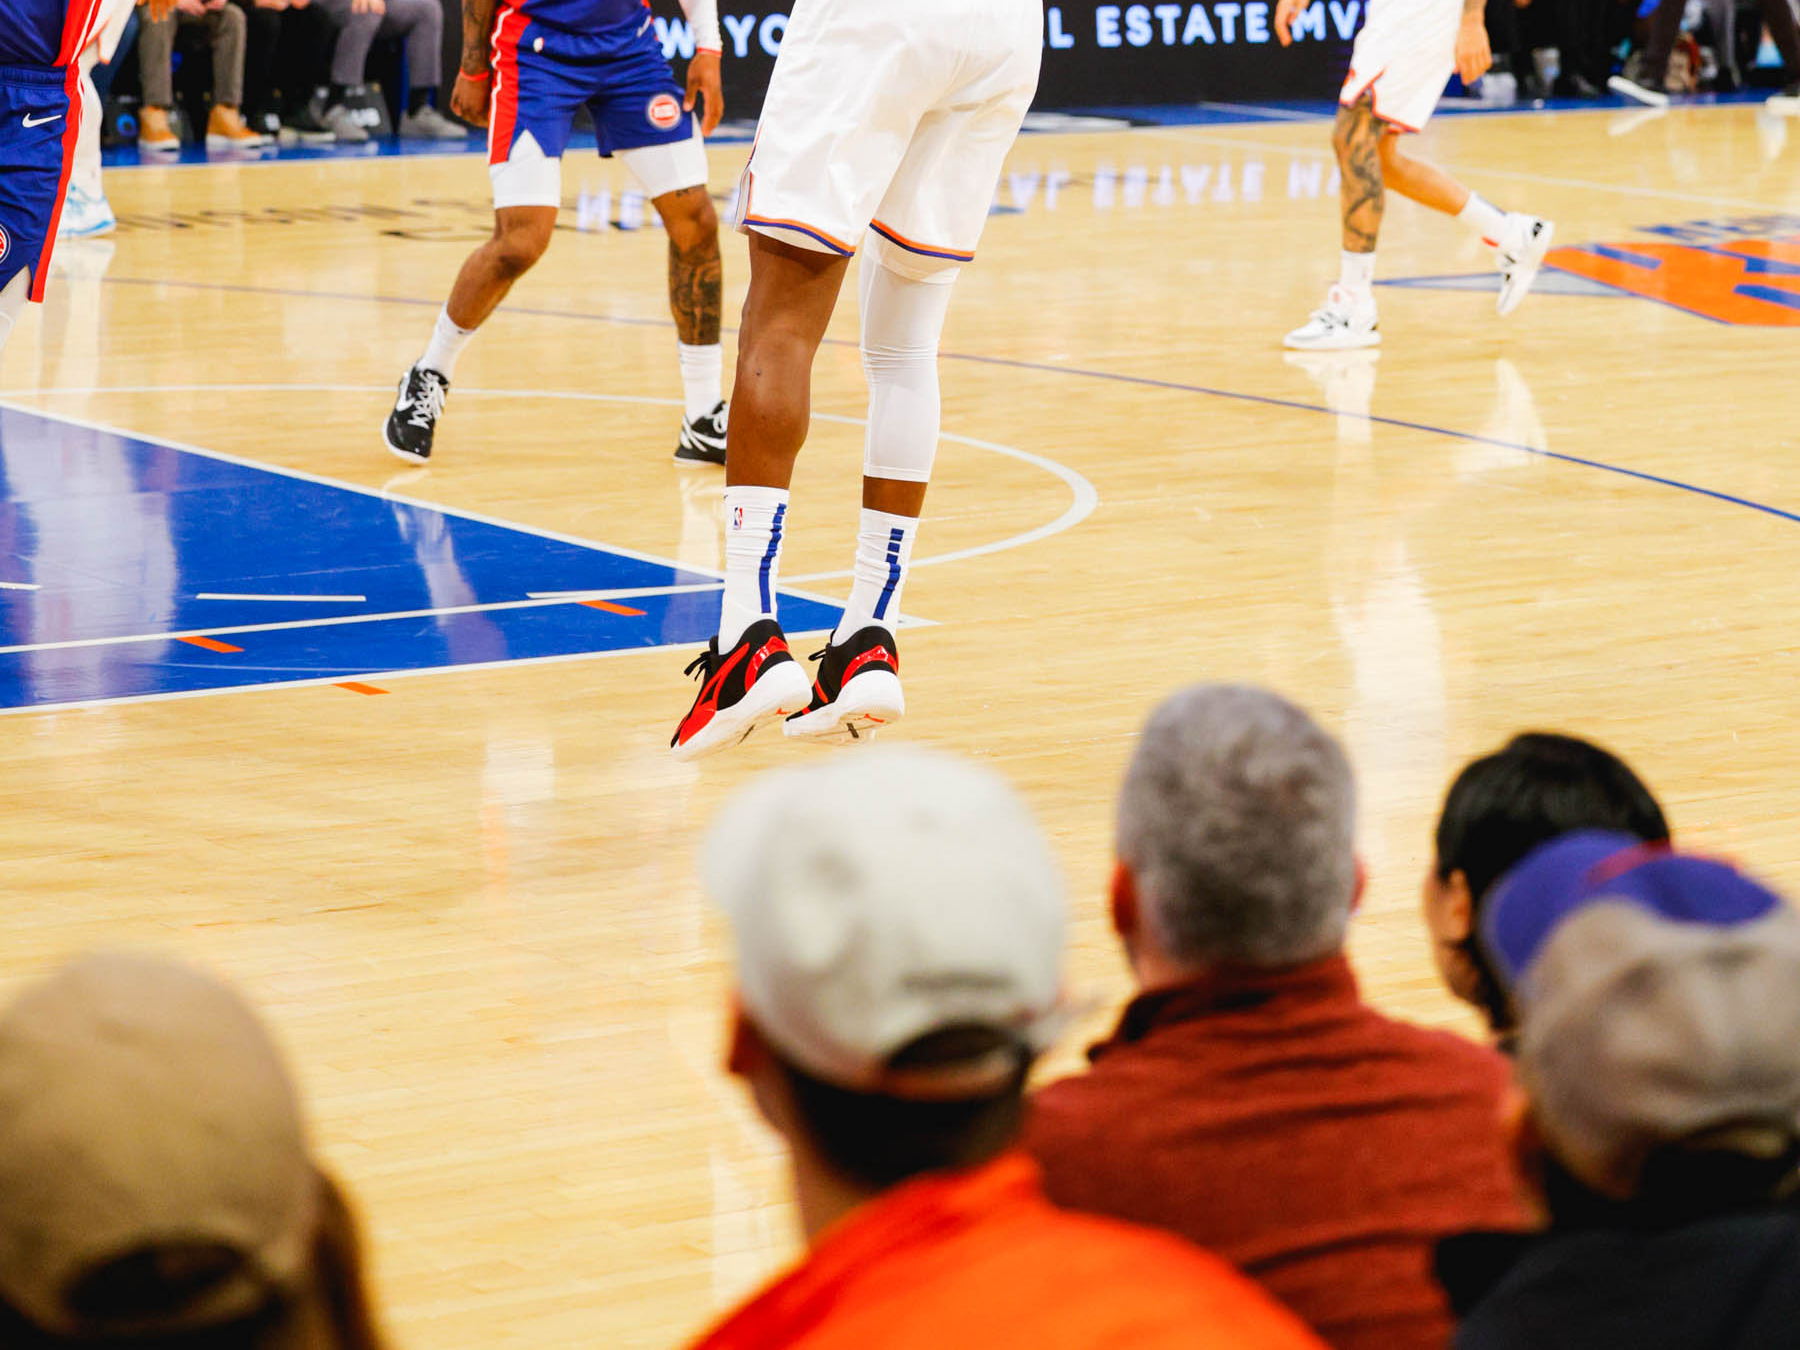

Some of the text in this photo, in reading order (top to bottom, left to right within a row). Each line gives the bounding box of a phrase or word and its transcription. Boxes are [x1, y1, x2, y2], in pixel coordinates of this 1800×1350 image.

[722, 12, 790, 58] YO
[1042, 6, 1075, 49] L
[1095, 1, 1271, 48] ESTATE
[1292, 0, 1371, 42] MV
